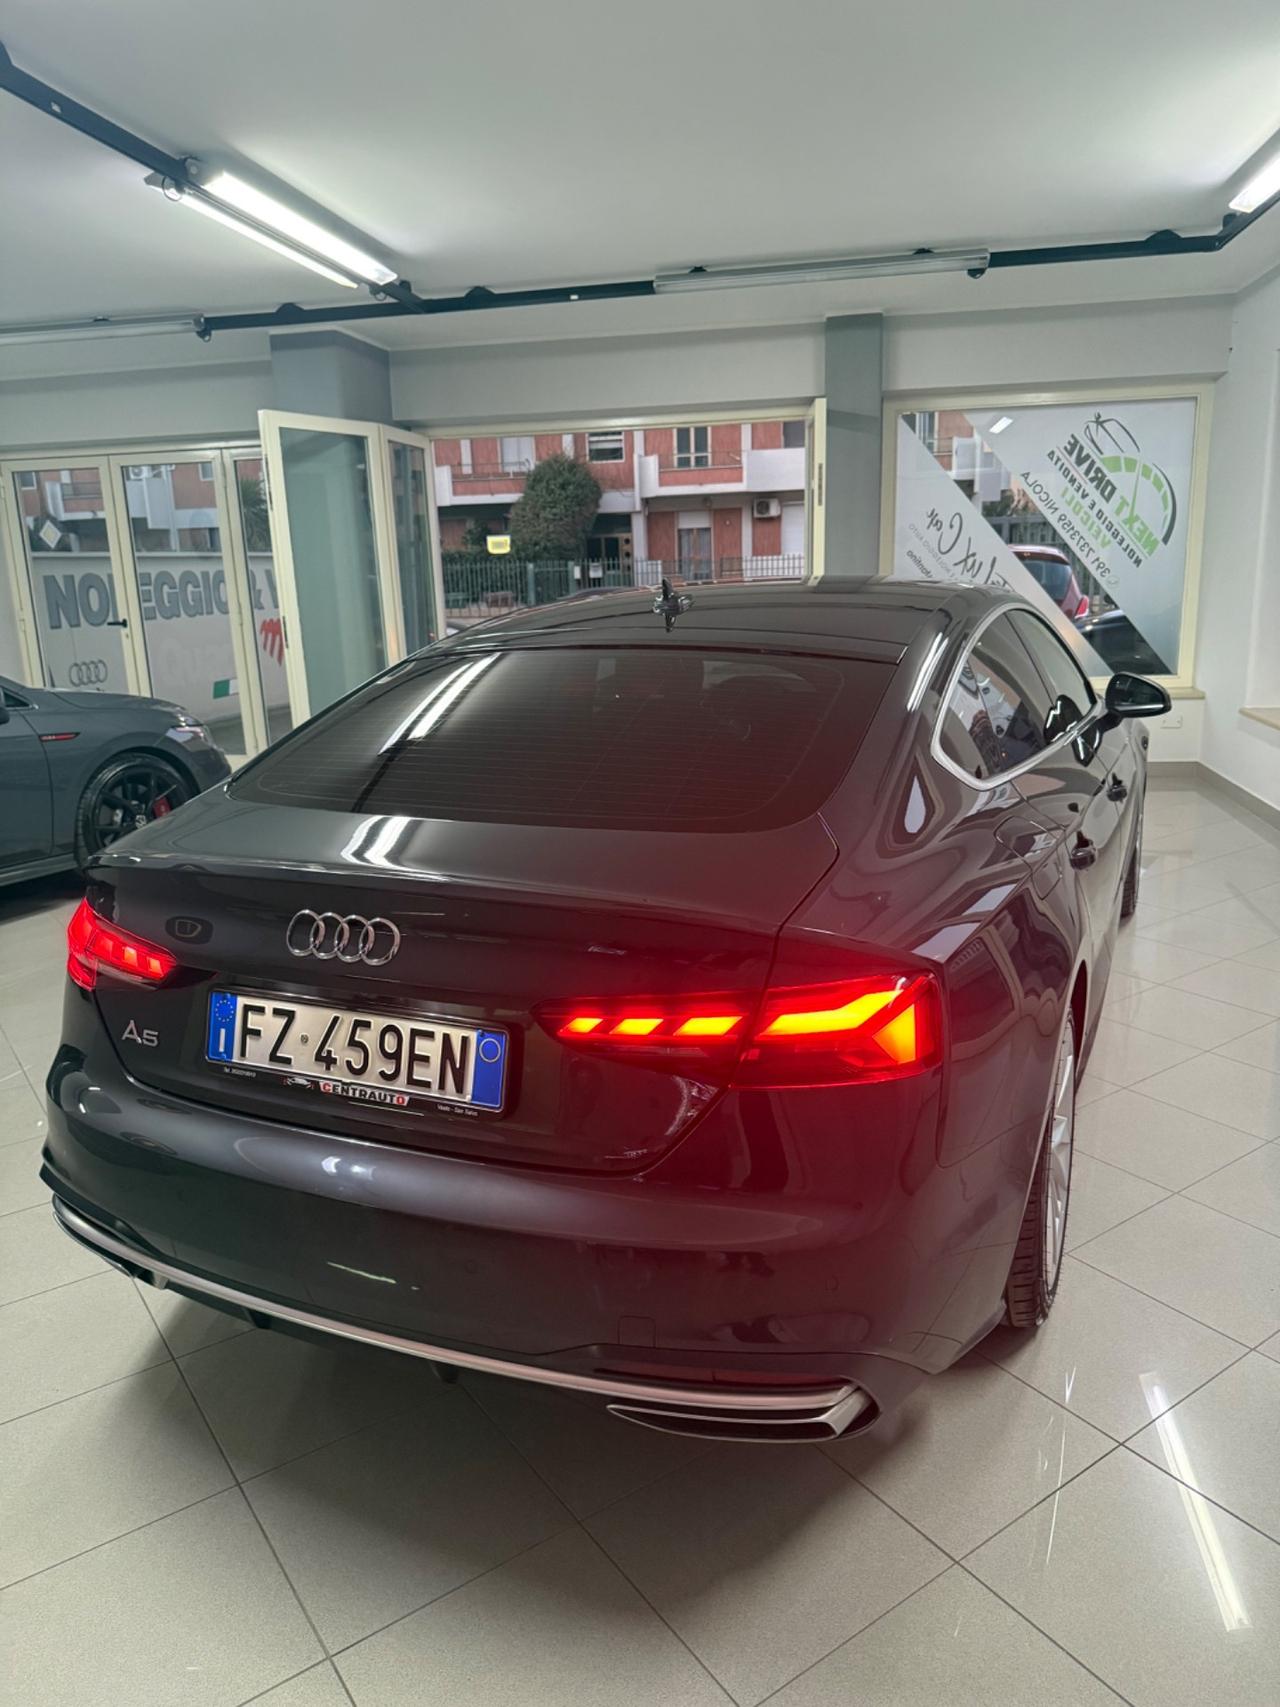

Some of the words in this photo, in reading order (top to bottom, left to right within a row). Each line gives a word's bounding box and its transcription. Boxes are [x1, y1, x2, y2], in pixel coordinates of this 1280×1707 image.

[121, 1019, 159, 1047] A5
[219, 1028, 226, 1053] I
[240, 1003, 297, 1066] FZ
[314, 1014, 470, 1095] 459EN
[321, 1081, 406, 1106] CENTRAUTO
